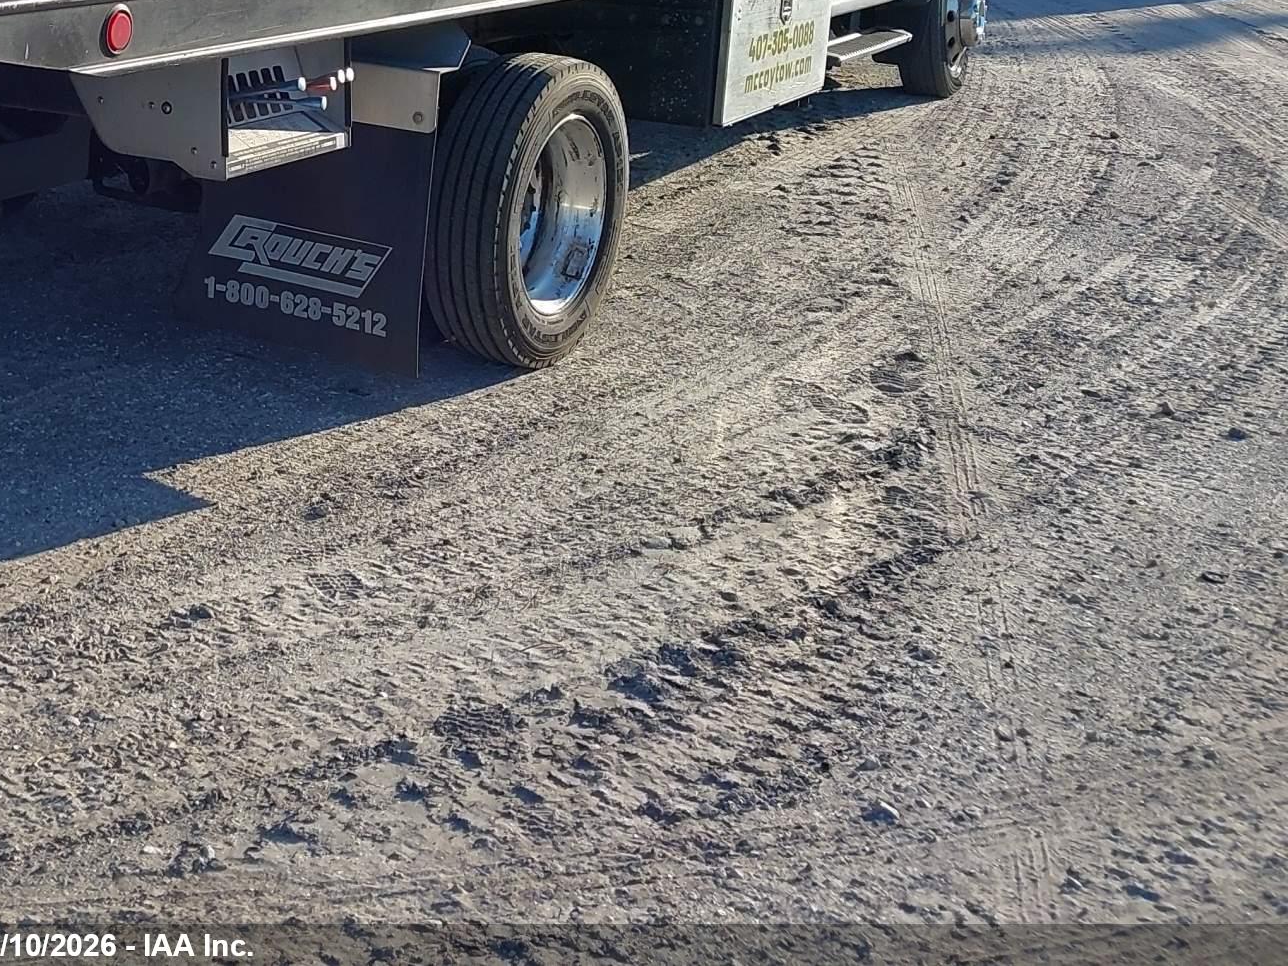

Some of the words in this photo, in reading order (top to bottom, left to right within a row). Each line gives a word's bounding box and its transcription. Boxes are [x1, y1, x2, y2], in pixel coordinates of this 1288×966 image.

[748, 20, 815, 63] 407-305-0088
[744, 55, 812, 94] mccoytow.com
[208, 215, 383, 281] CROUCH'S
[204, 276, 387, 337] 1-800-628-5212
